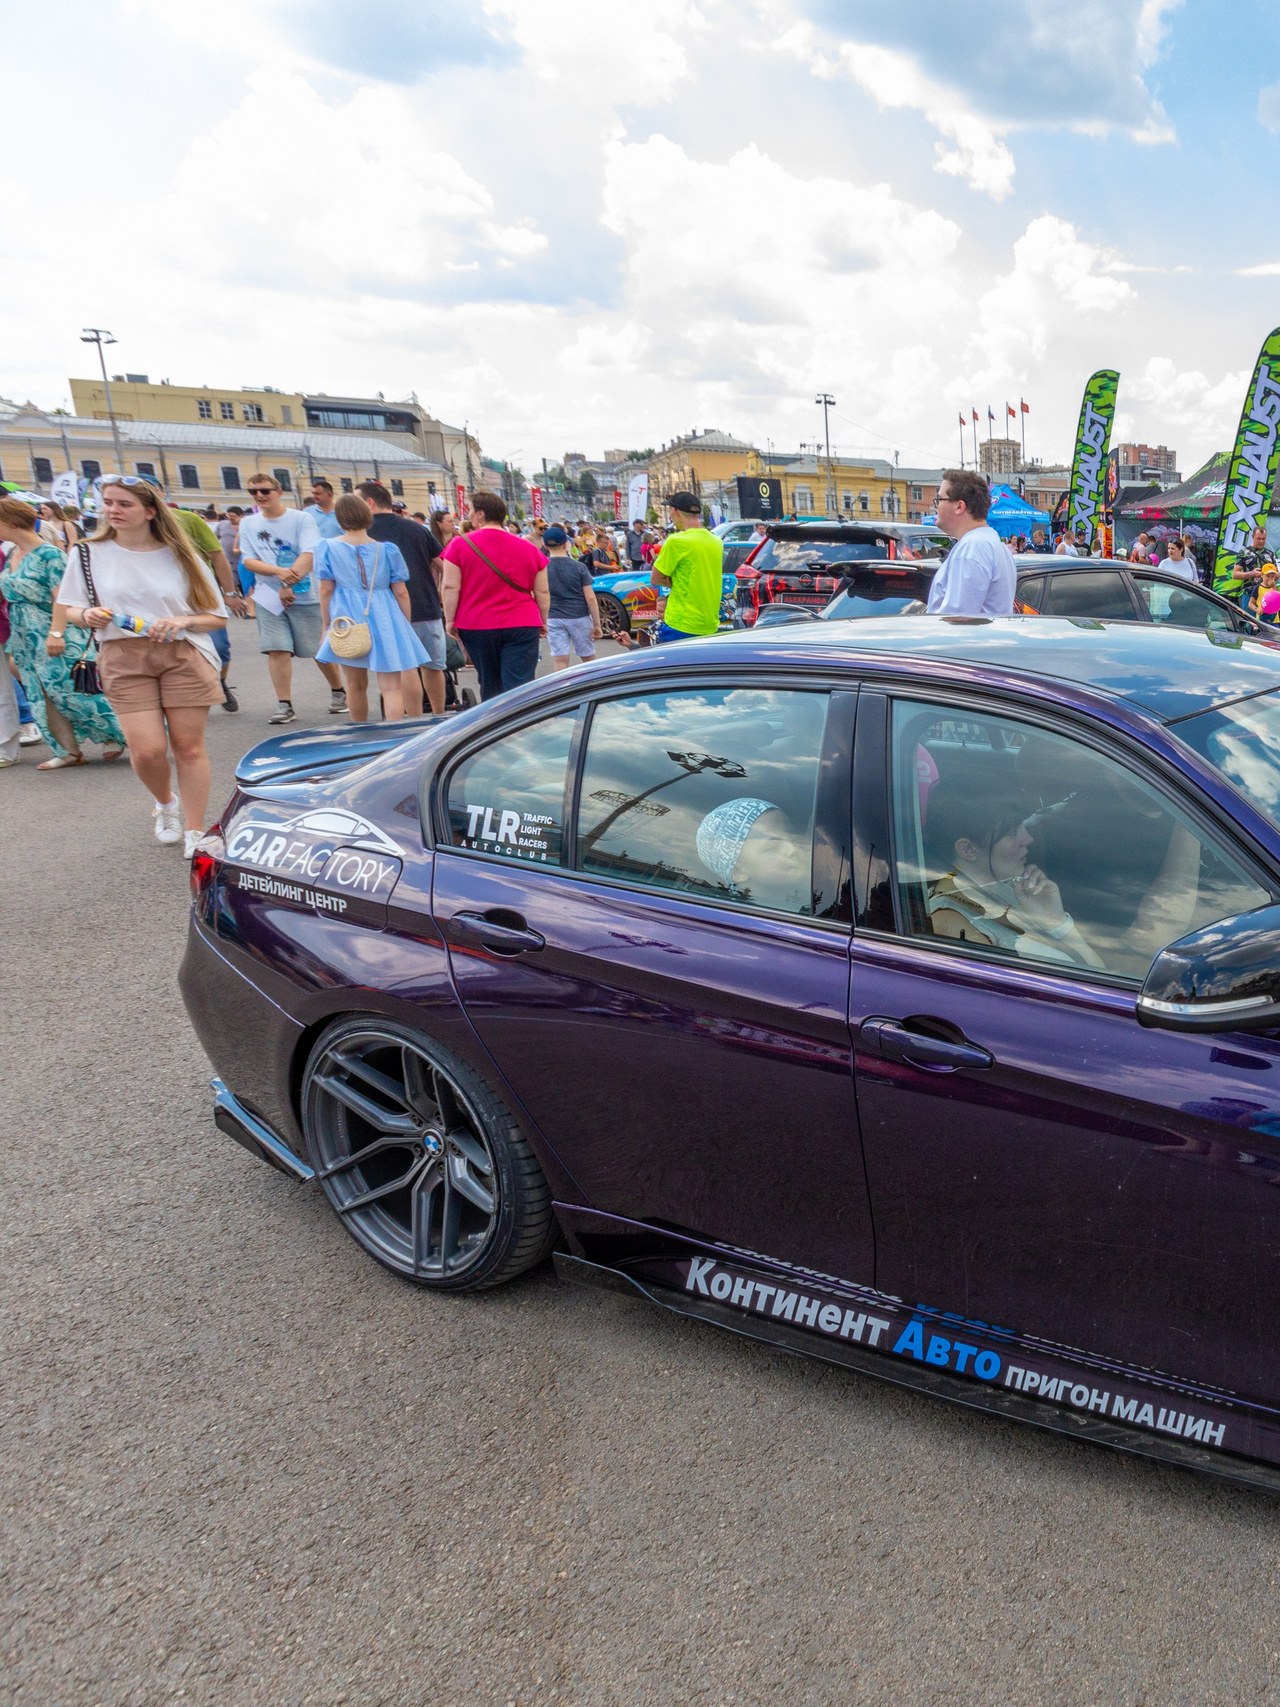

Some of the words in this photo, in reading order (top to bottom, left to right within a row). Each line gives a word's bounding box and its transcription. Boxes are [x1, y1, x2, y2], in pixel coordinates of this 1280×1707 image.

[466, 804, 522, 845] TLR
[520, 825, 542, 837] LIGHT
[523, 812, 553, 825] TRAFFIC
[518, 837, 548, 850] RACERS
[239, 871, 304, 903] ДЕТЕЙЛИНГ
[305, 891, 348, 913] ЦЕНТР
[1110, 1398, 1226, 1448] МАШИН
